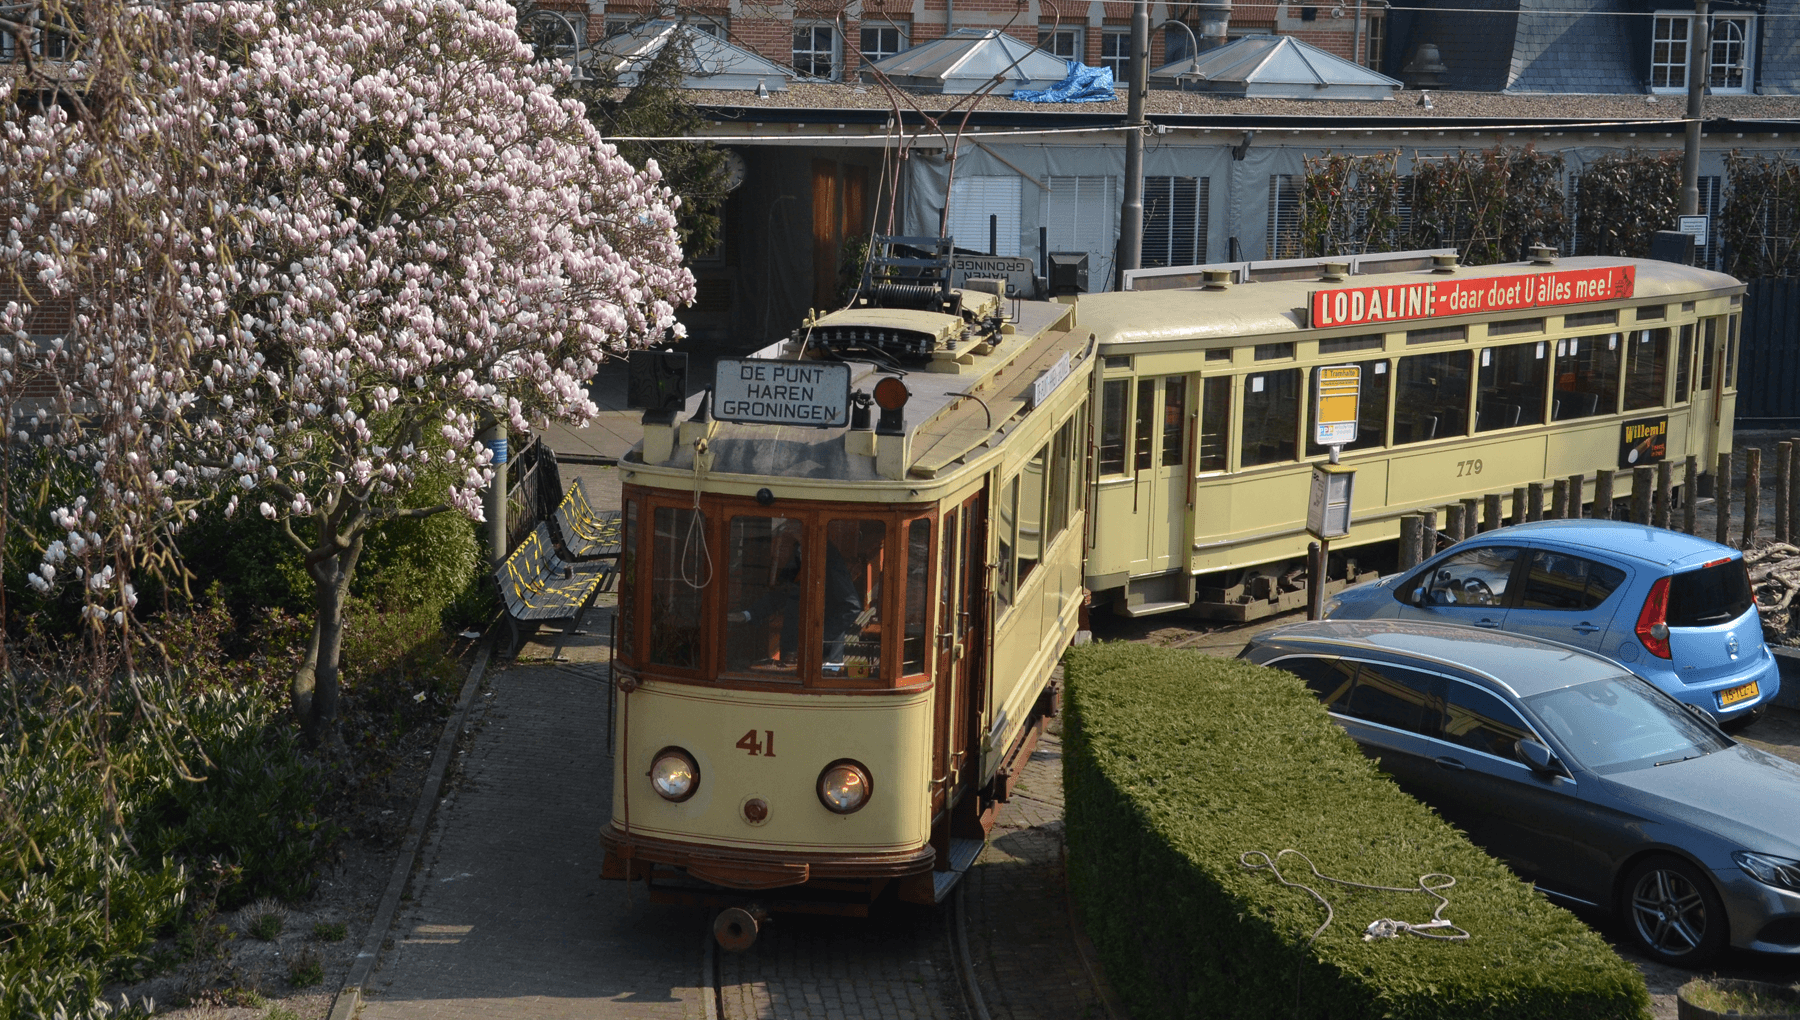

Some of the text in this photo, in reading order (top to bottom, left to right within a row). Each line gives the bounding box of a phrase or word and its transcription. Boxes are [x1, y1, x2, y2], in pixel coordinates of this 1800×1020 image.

[1322, 285, 1437, 324] LODALINE
[1488, 280, 1521, 307] doet
[1525, 277, 1535, 303] U
[1576, 270, 1612, 298] mee!
[740, 366, 824, 384] DE PUNT
[748, 384, 814, 402] HAREN
[723, 400, 837, 421] GRONINGEN
[1625, 424, 1659, 444] Willem
[1456, 458, 1483, 478] 779
[736, 729, 776, 757] 41
